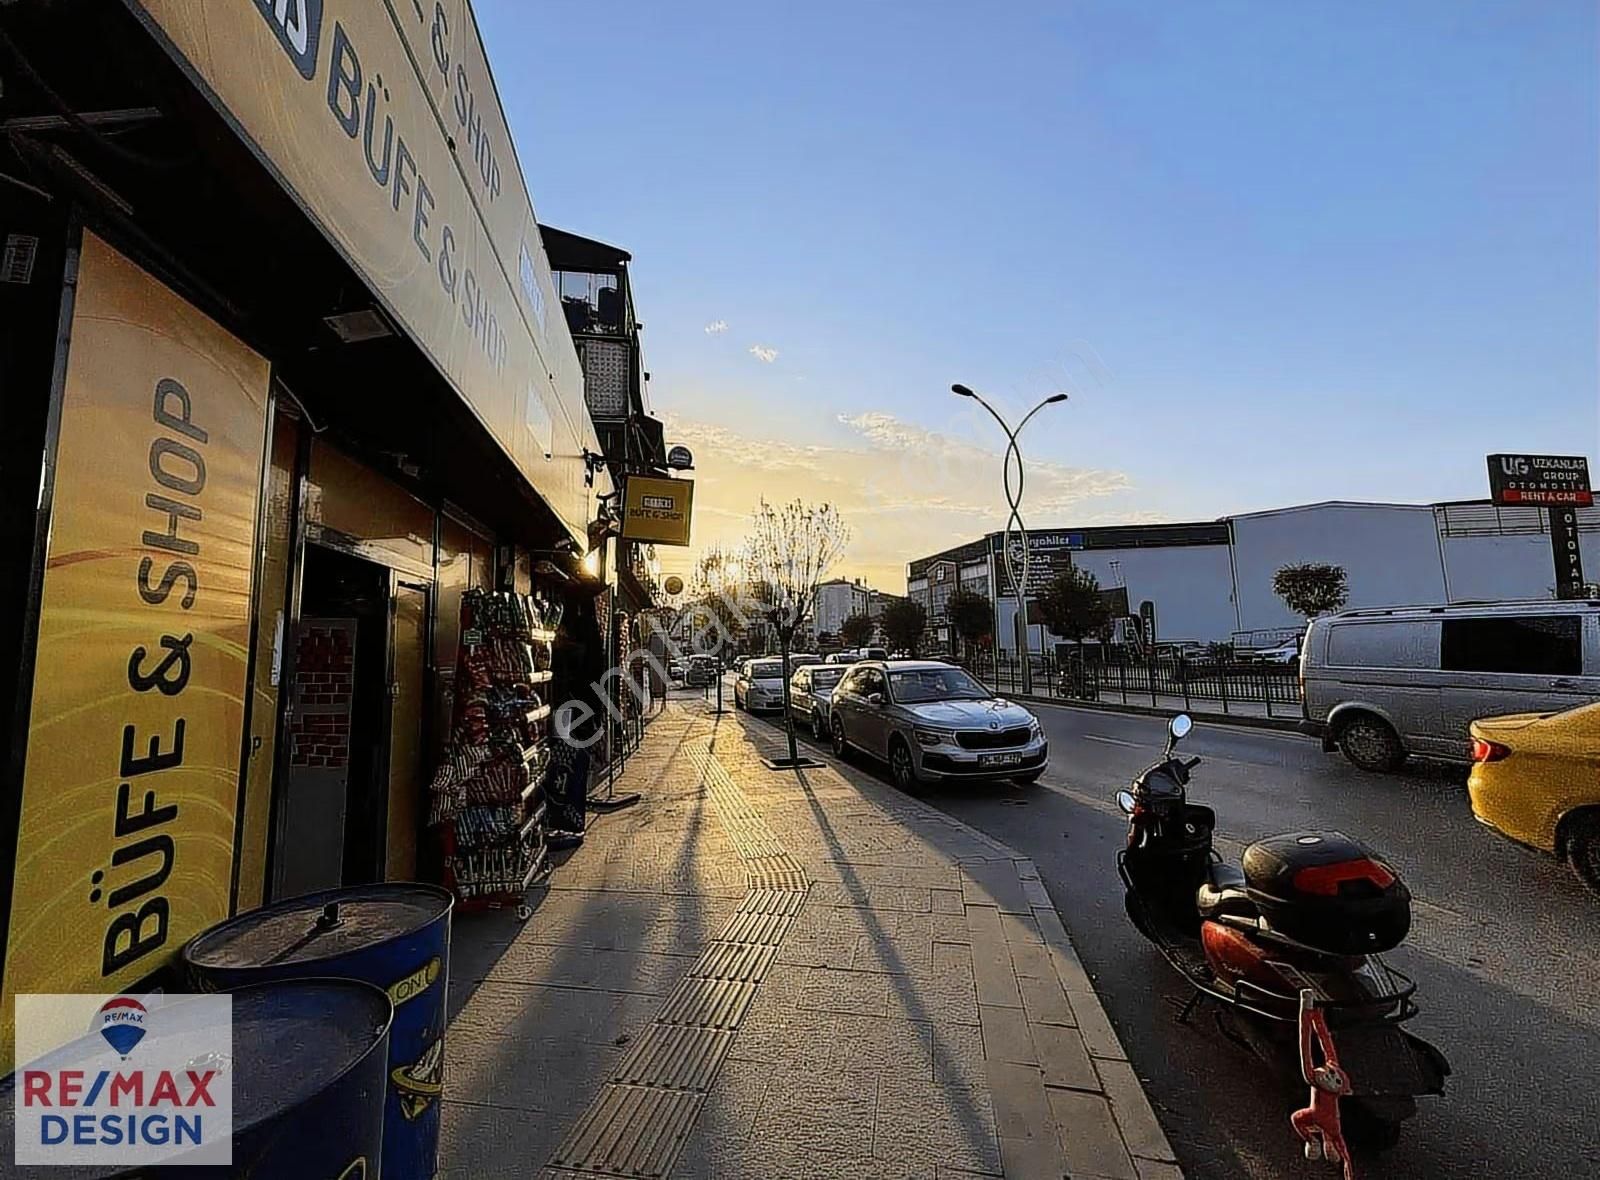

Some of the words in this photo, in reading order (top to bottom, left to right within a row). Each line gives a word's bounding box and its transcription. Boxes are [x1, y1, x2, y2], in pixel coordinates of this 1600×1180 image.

[327, 20, 436, 263] BÜFE
[438, 225, 457, 304] &
[461, 269, 508, 377] SHOP
[454, 63, 501, 203] SHOP
[137, 377, 209, 611] SHOP
[1520, 491, 1546, 501] RENT
[1556, 492, 1577, 502] CAR
[1543, 471, 1580, 481] GROUP
[127, 632, 193, 697] &
[89, 717, 187, 978] BÜFE
